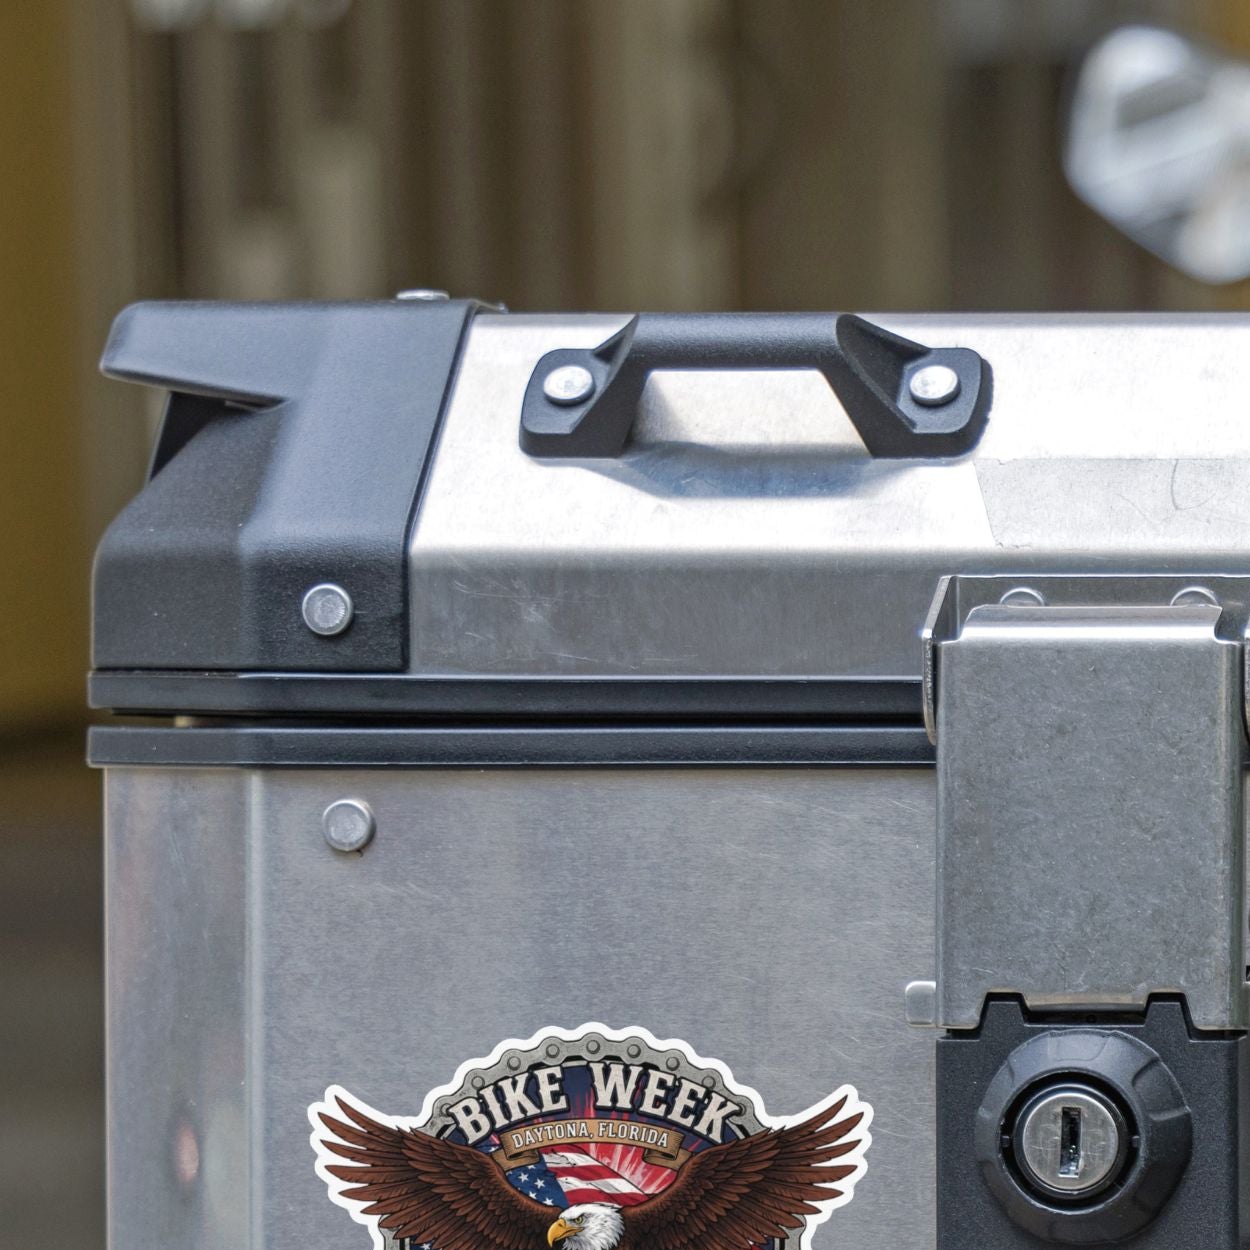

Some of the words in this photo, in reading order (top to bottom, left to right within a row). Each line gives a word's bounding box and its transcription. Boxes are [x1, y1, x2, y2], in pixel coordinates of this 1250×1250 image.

[449, 1065, 568, 1145] BIKE
[589, 1062, 743, 1144] WEEK
[511, 1124, 593, 1149] DAYTONA,
[598, 1123, 669, 1148] FLORIDA
